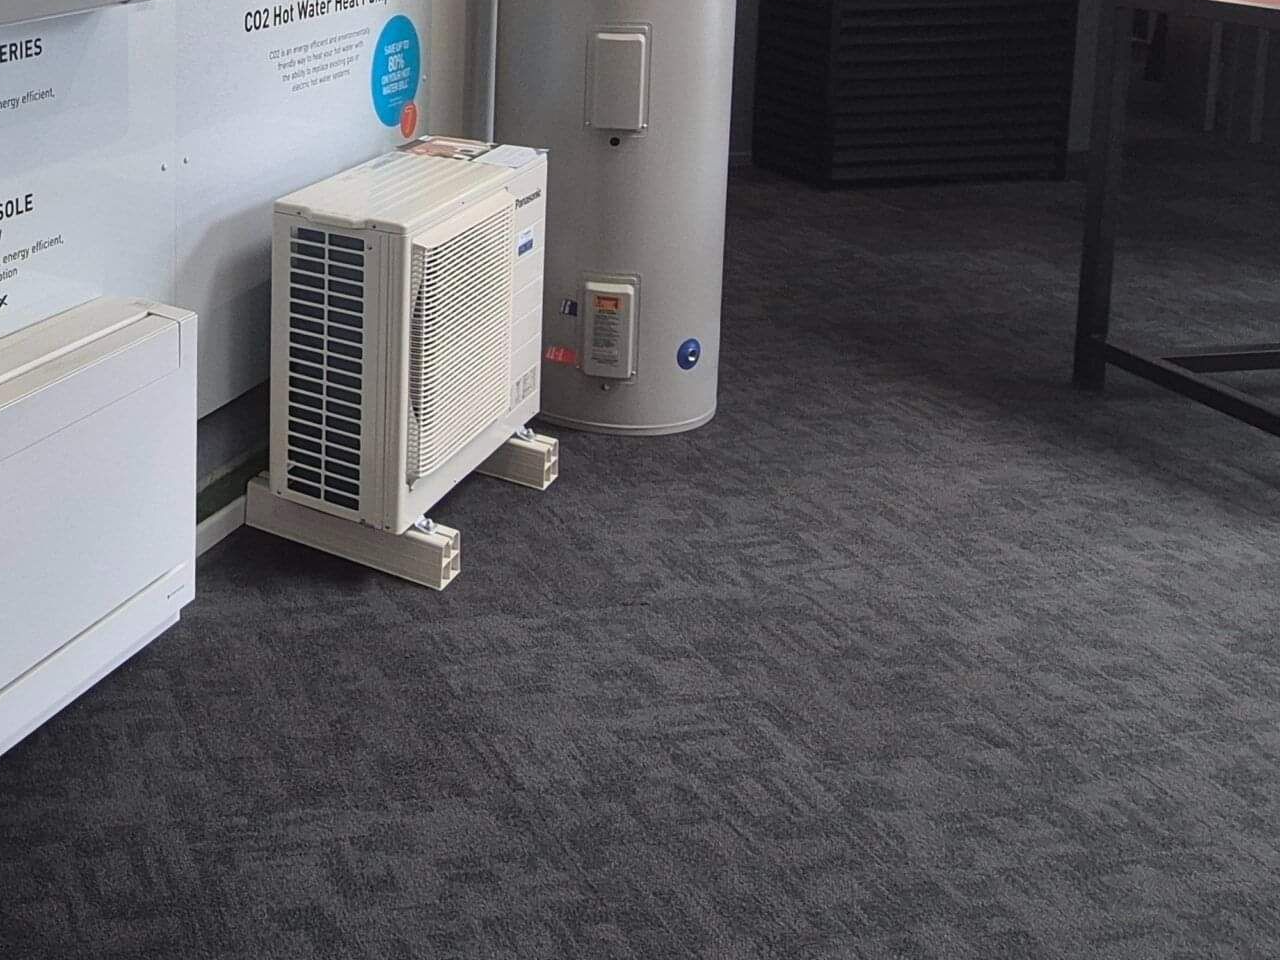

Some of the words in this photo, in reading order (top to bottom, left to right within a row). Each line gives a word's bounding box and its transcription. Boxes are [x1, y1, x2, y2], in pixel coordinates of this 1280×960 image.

[244, 7, 270, 33] CO2
[273, 4, 294, 27] Hot
[2, 247, 30, 265] energy
[31, 234, 64, 254] efficient,
